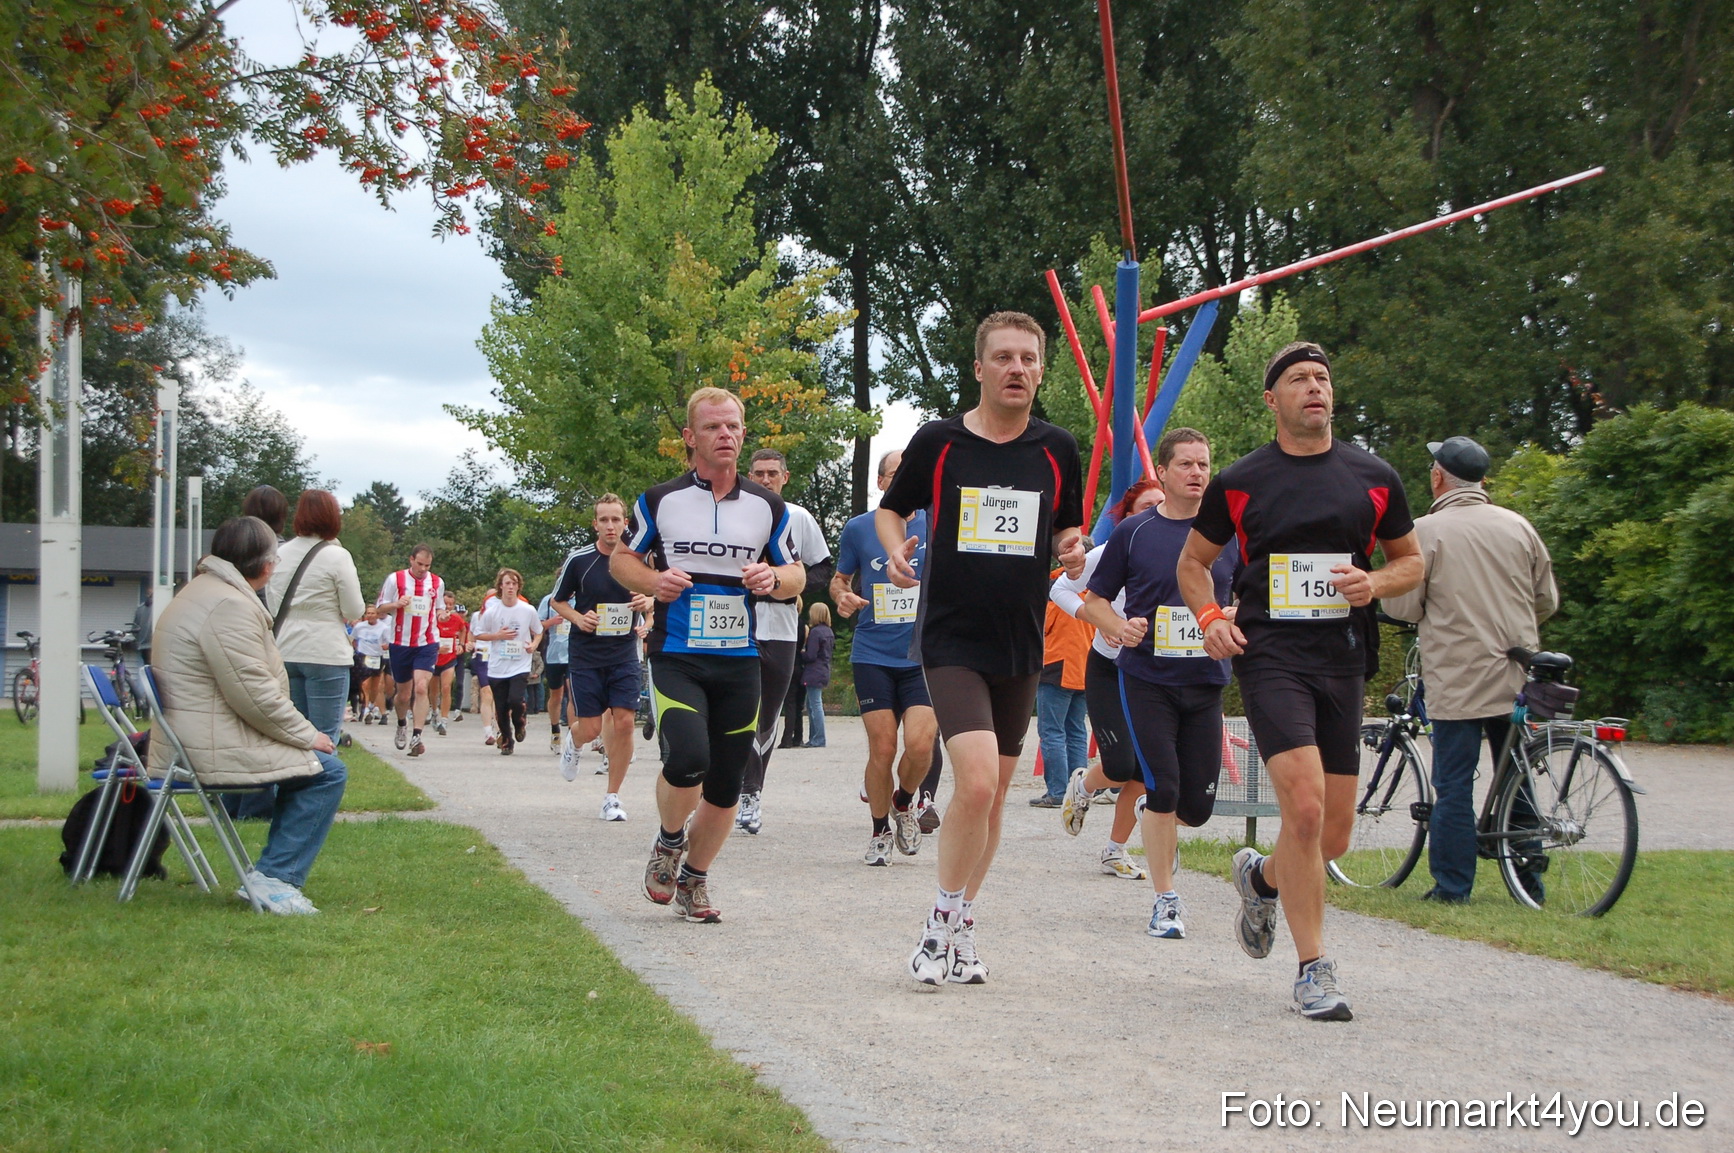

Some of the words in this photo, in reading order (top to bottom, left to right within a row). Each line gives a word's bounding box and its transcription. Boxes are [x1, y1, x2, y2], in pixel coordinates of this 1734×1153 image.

[982, 494, 1018, 511] Jürgen
[963, 511, 969, 522] B
[994, 515, 1019, 534] 23
[673, 541, 756, 560] SCOTT
[1292, 560, 1313, 573] Biwi
[1273, 578, 1279, 589] C
[1300, 580, 1337, 598] 150
[885, 587, 904, 595] Heinz
[709, 599, 730, 610] Klaus
[892, 598, 915, 611] 737
[611, 616, 629, 626] 262
[694, 614, 699, 622] C
[709, 615, 745, 630] 3374
[1171, 611, 1190, 622] Bert
[1157, 625, 1162, 633] C
[1178, 627, 1205, 641] 149
